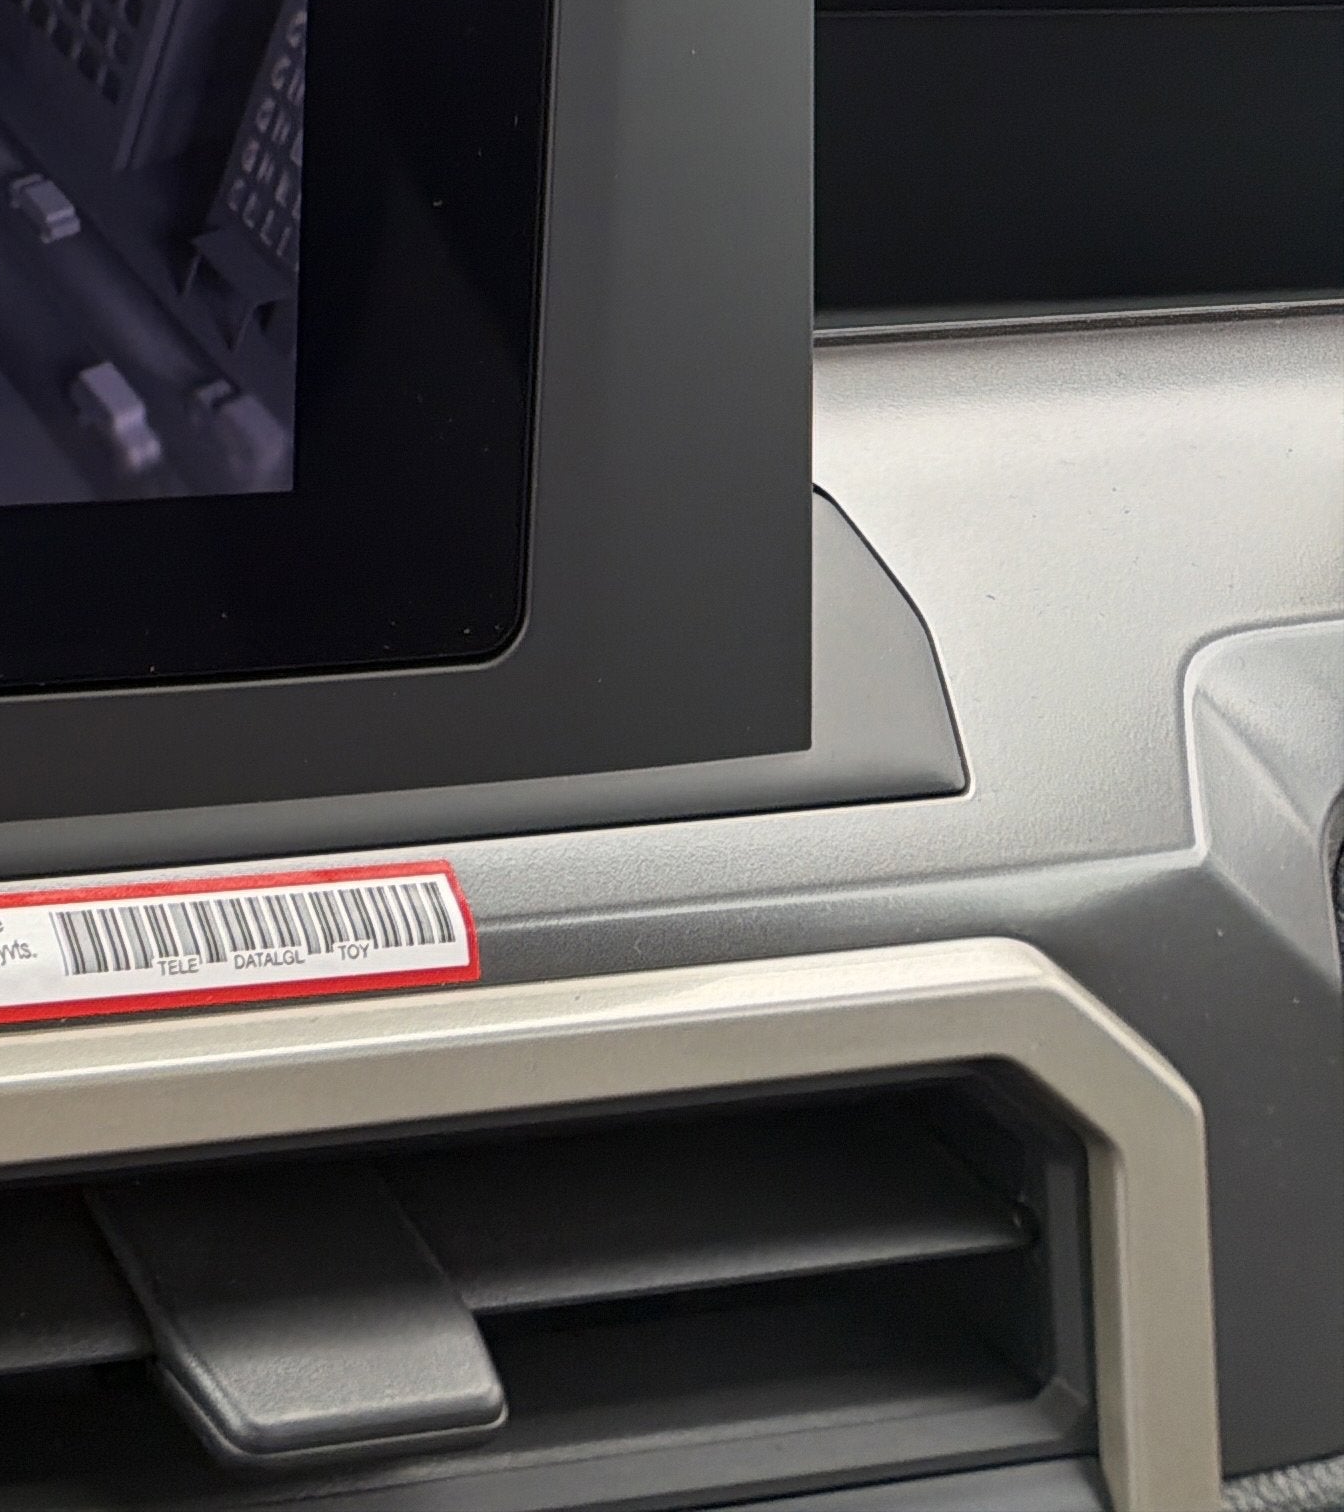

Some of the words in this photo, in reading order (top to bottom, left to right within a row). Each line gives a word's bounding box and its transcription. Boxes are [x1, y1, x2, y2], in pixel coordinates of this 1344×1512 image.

[158, 956, 200, 977] TELE
[233, 947, 306, 970] DATALGL
[335, 942, 370, 962] TOY
